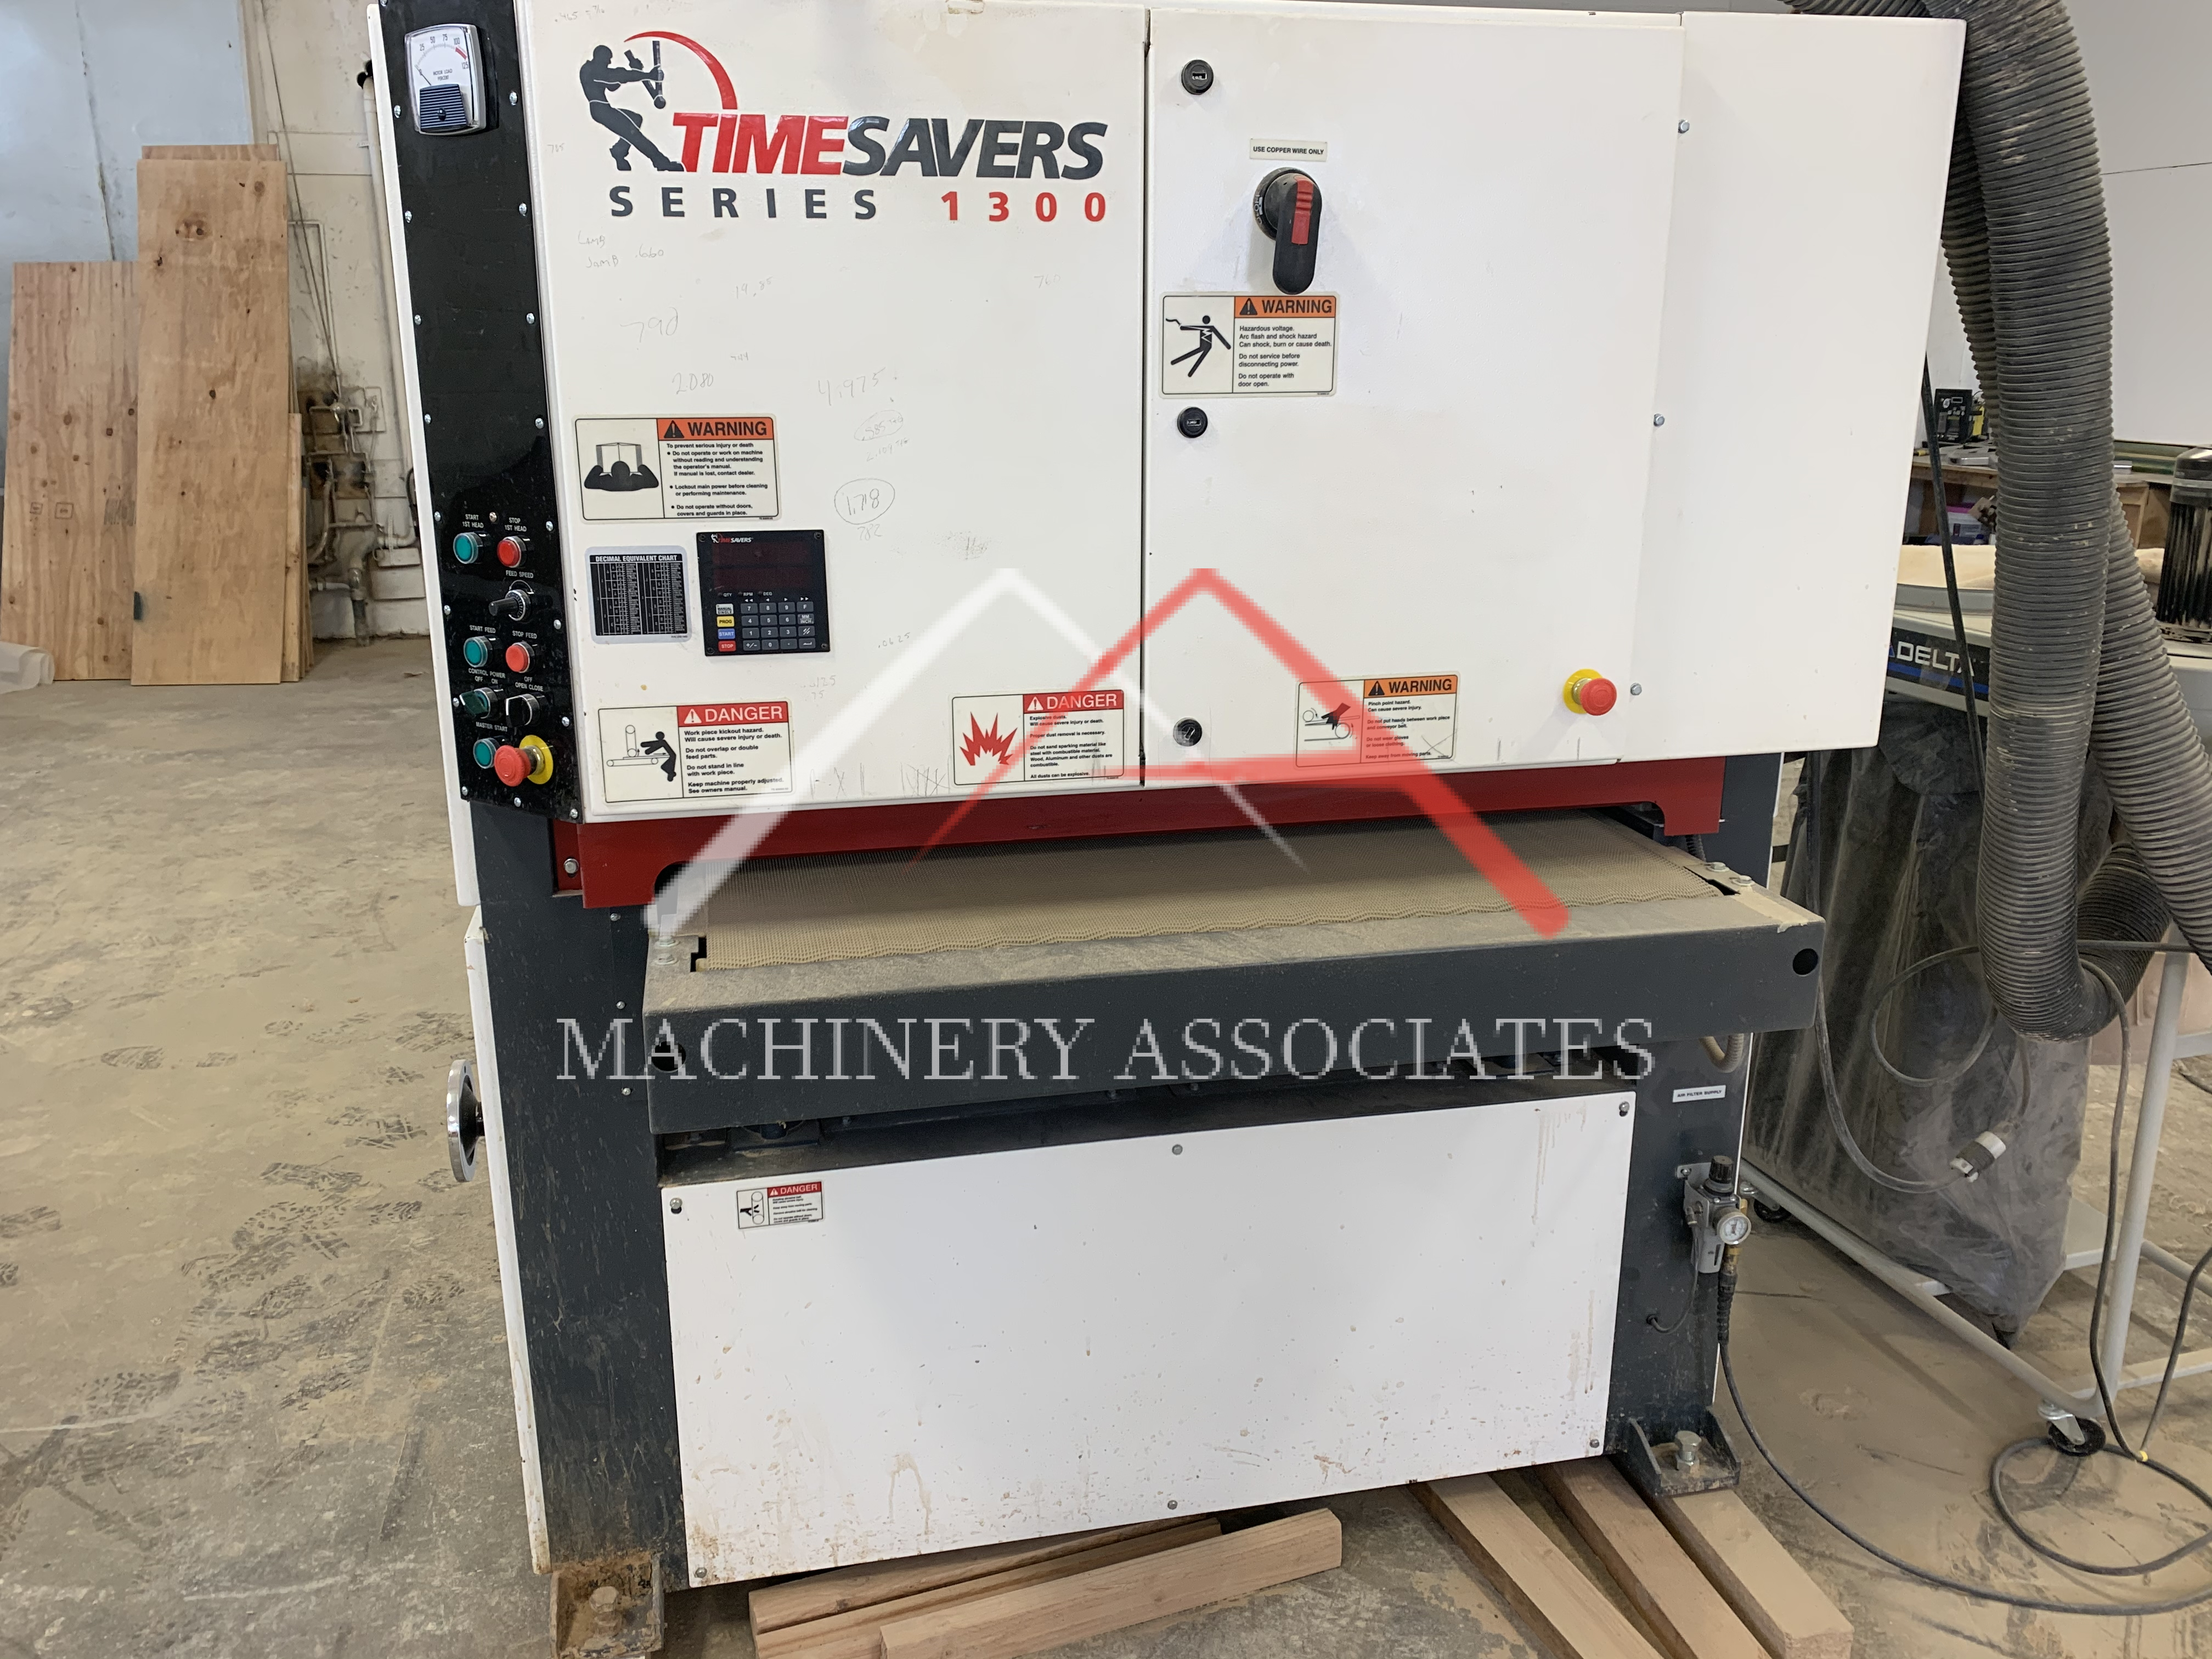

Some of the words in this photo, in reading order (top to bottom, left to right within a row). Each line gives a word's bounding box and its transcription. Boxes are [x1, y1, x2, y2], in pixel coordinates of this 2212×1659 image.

[673, 112, 1108, 180] TIMESAVERS
[609, 185, 876, 219] SERIES
[941, 191, 1106, 222] 1300
[1262, 299, 1332, 314] WARNING
[687, 421, 767, 436] WARNING
[468, 668, 488, 676] CONTROL
[1389, 679, 1452, 693] WARNING
[1047, 693, 1117, 709] DANGER
[705, 706, 783, 722] DANGER
[494, 724, 508, 732] START
[780, 1184, 817, 1194] DANGER
